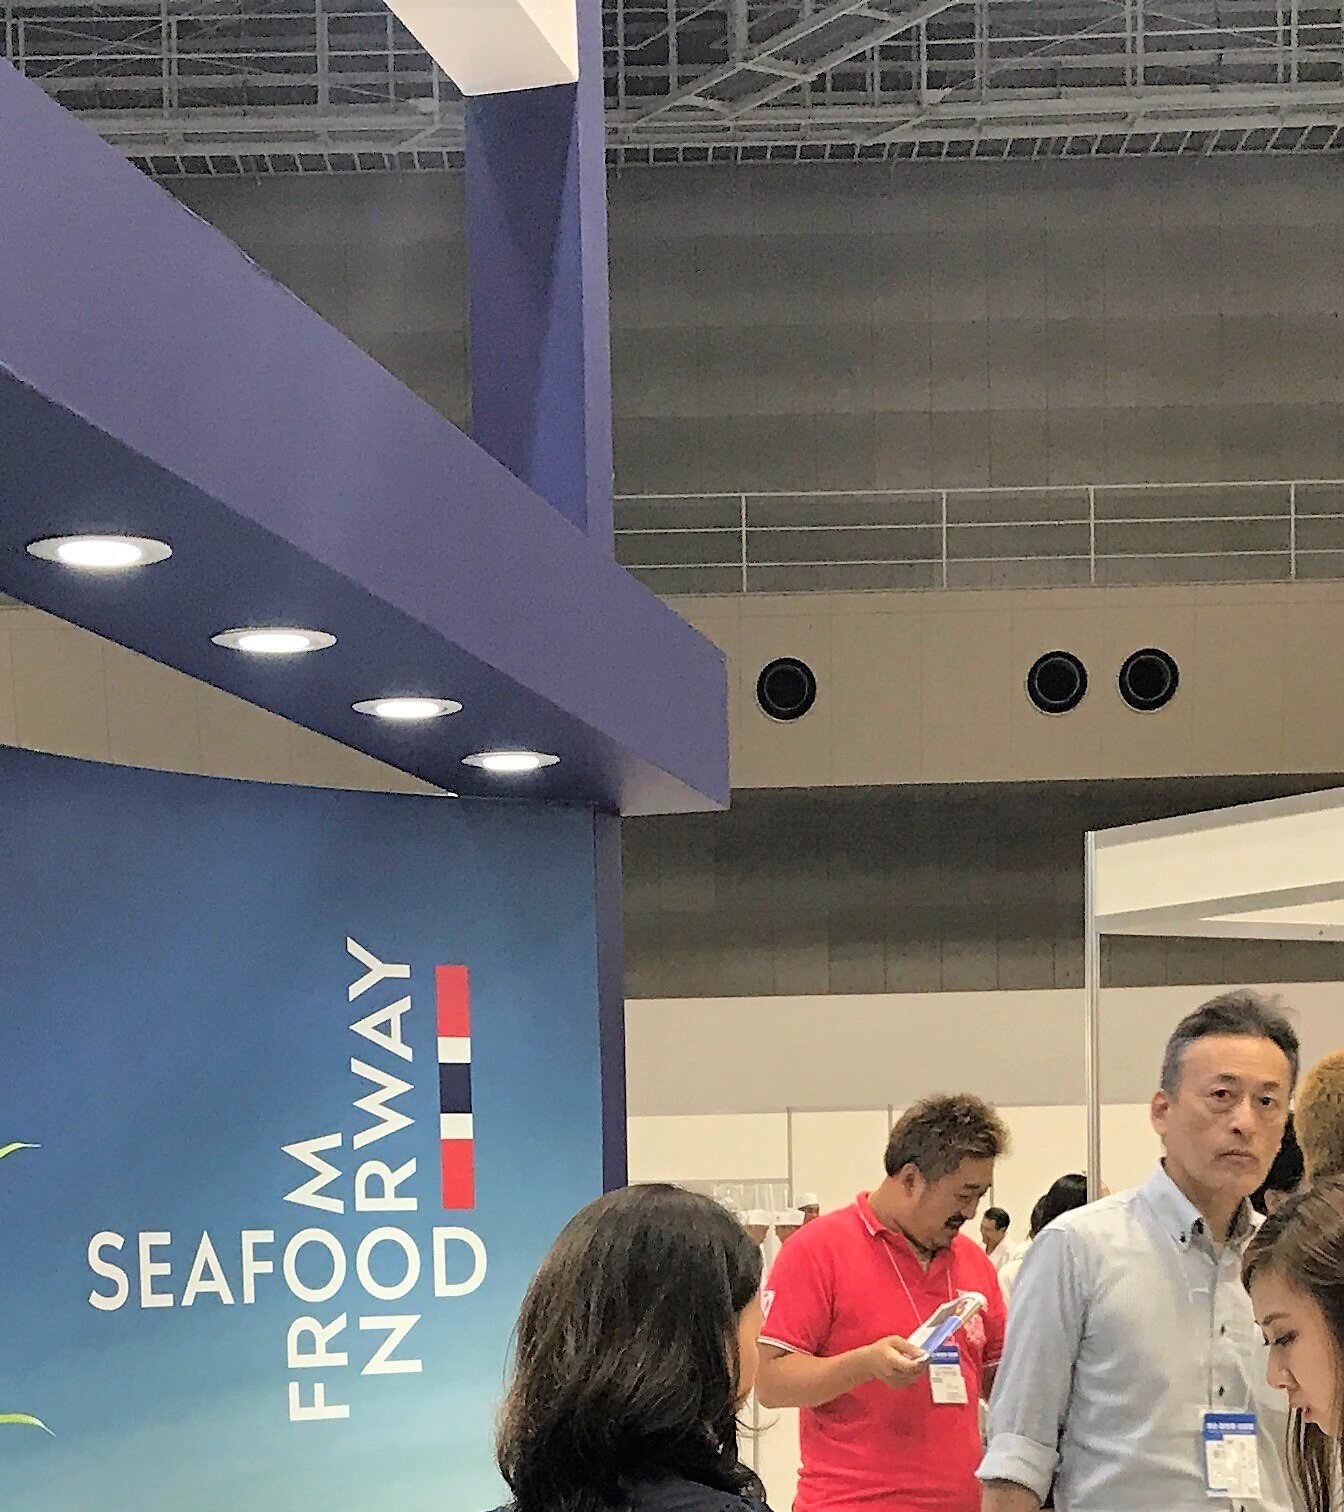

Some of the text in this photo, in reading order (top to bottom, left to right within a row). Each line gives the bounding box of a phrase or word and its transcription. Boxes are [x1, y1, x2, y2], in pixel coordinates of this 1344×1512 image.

[87, 1227, 488, 1310] SEAFOOD
[281, 937, 422, 1421] FROM NORWAY
